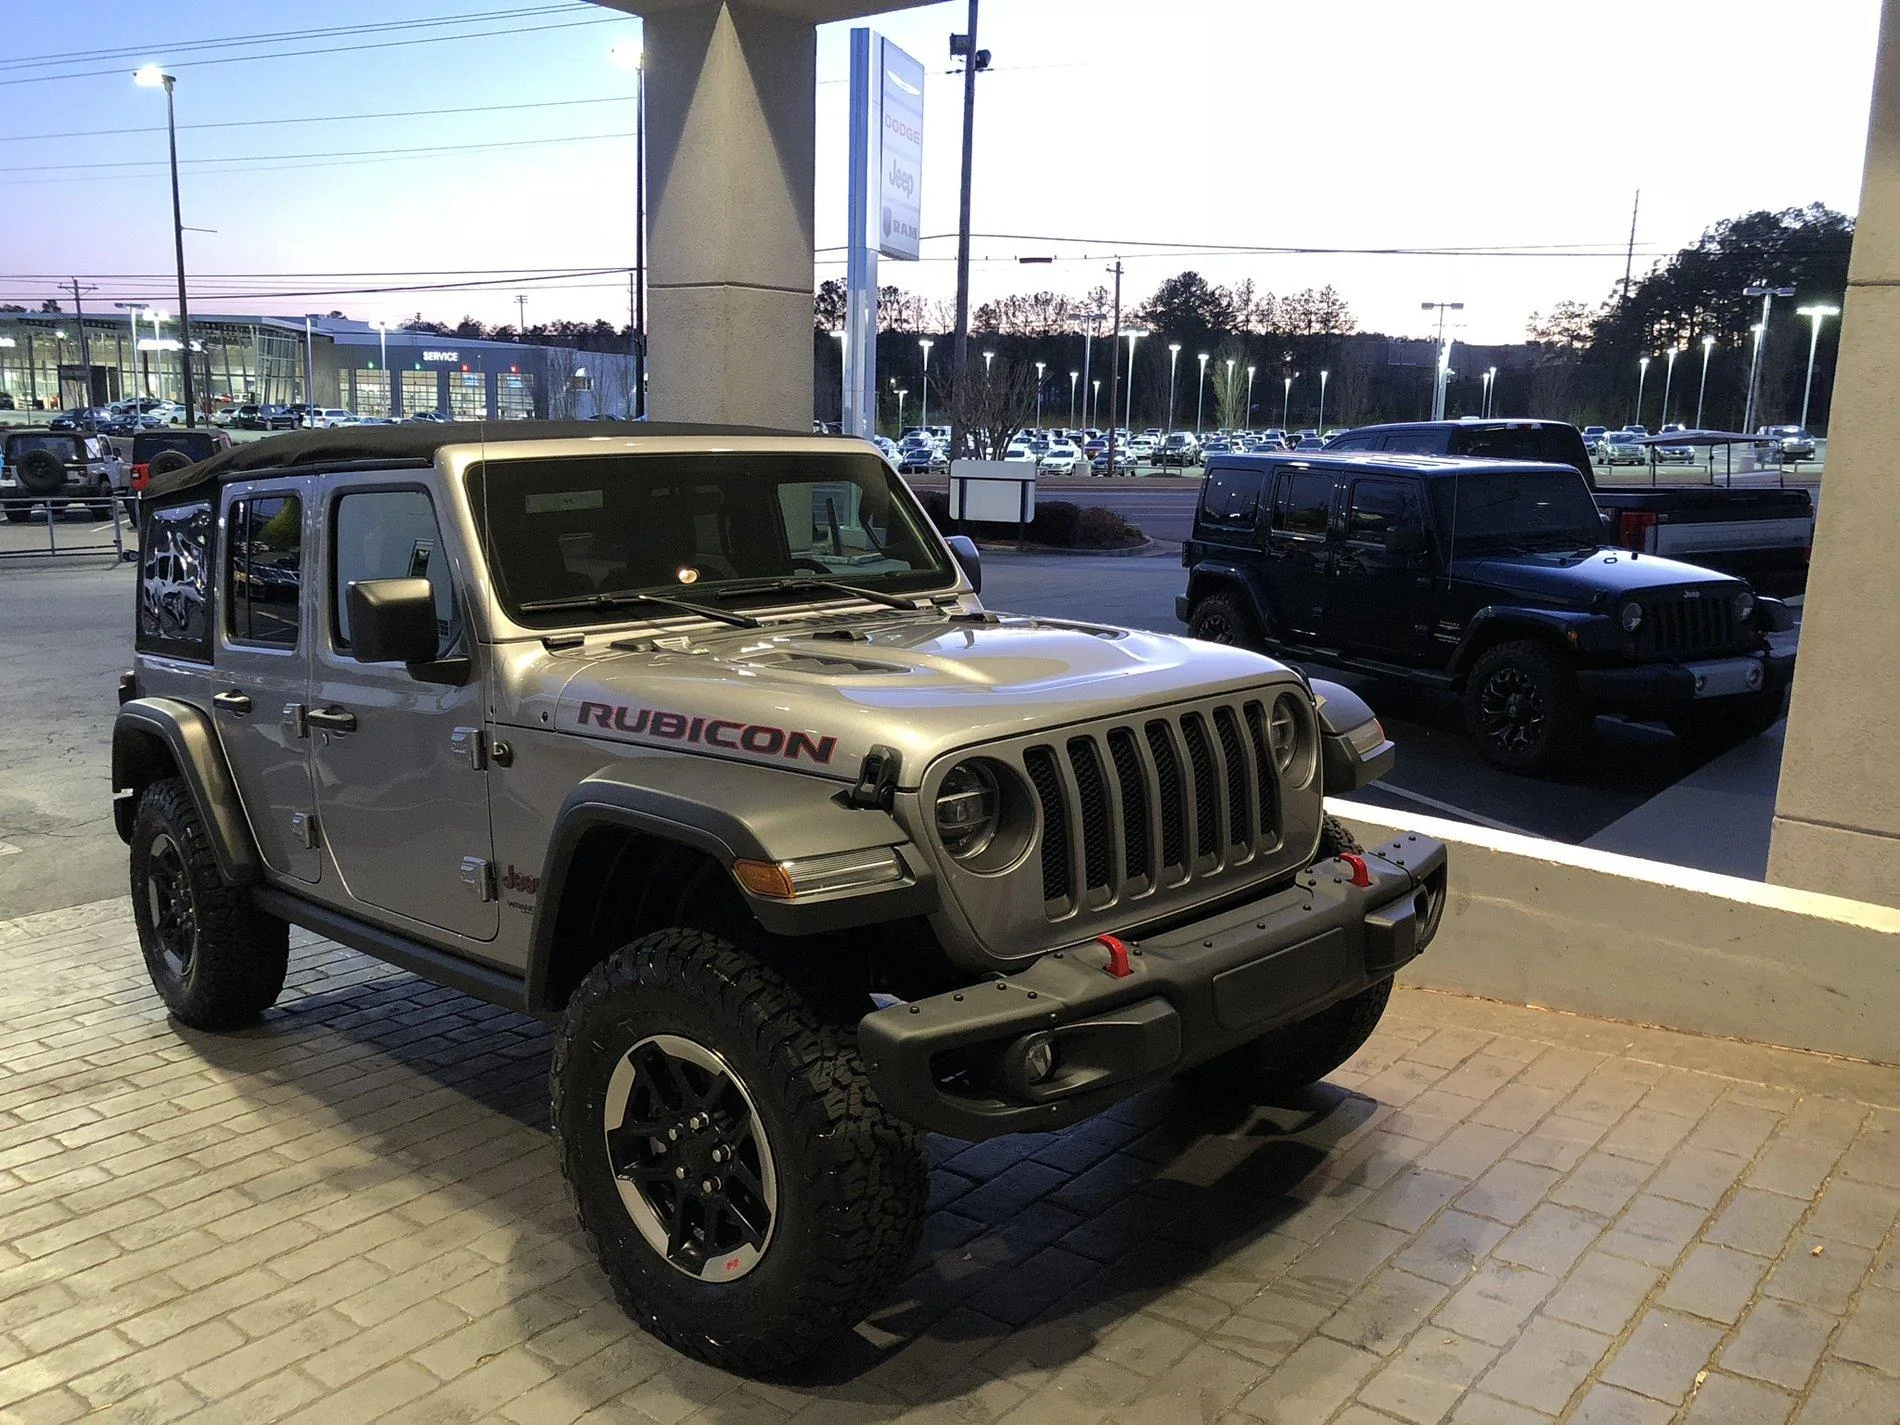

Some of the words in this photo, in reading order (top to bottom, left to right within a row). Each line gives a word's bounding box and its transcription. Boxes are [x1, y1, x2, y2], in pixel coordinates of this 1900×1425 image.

[885, 114, 920, 144] DODGE
[889, 159, 913, 199] Jeep
[893, 219, 918, 240] RAM
[423, 351, 458, 361] SERVICE
[577, 701, 837, 765] RUBICON
